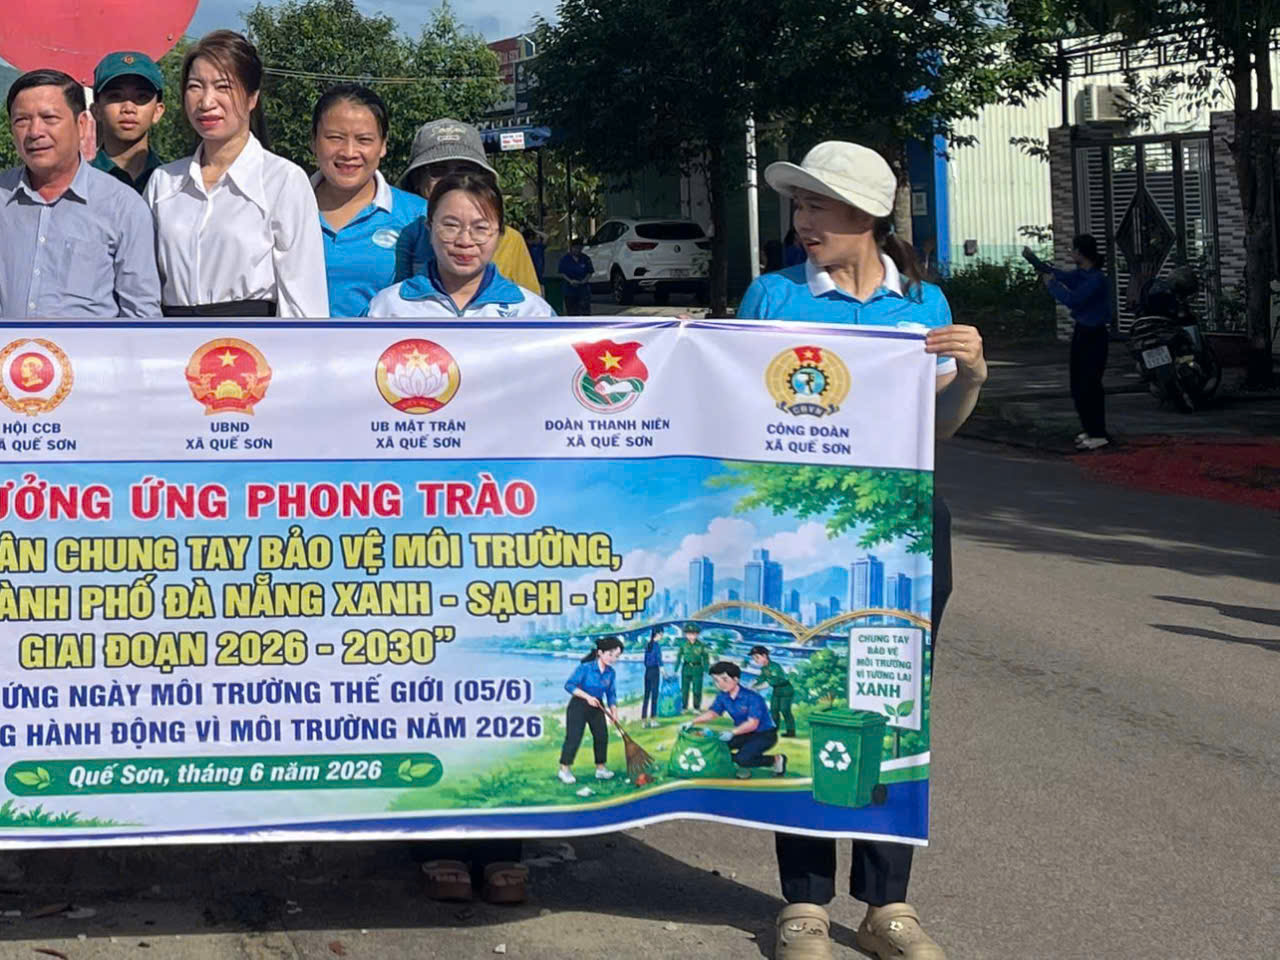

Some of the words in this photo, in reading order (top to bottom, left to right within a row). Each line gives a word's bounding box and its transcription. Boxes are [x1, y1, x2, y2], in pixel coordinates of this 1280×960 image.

[3, 421, 27, 435] HỘI
[32, 423, 61, 434] CCB
[210, 422, 249, 433] UBND
[371, 422, 389, 432] UB
[429, 419, 466, 435] TRẬN
[545, 417, 583, 431] ĐOÀN
[588, 420, 636, 430] THANH
[642, 418, 670, 430] NIÊN
[767, 422, 805, 436] CÔNG
[810, 425, 849, 438] ĐOÀN
[12, 436, 43, 452] QUẾ
[47, 439, 77, 450] SƠN
[186, 438, 204, 450] XÃ
[210, 435, 241, 450] QUẾ
[244, 438, 273, 449] SƠN
[376, 436, 394, 449] XÃ
[400, 434, 429, 449] QUẾ
[433, 437, 461, 448] SƠN
[566, 436, 586, 447] XÃ
[591, 433, 621, 448] QUẾ
[626, 436, 653, 447] SƠN
[765, 438, 783, 451] XÃ
[788, 439, 818, 454] QUẾ
[822, 442, 851, 455] SƠN
[131, 477, 228, 519] ỨNG
[247, 483, 401, 518] PHONG
[418, 474, 536, 516] TRÀO
[55, 536, 178, 572] CHUNG
[187, 536, 251, 571] TAY
[259, 525, 333, 569] BẢO
[340, 528, 386, 575] VỆ
[393, 527, 462, 568] MÔI
[470, 525, 622, 571] TRƯỜNG,
[78, 574, 157, 620] PHỐ
[163, 577, 216, 619] ĐÀ
[224, 573, 324, 617] NẴNG
[331, 581, 433, 617] XANH
[440, 593, 459, 608] -
[466, 578, 563, 623] SẠCH
[569, 591, 588, 606] -
[594, 577, 654, 620] ĐẸP
[858, 634, 890, 644] CHUNG
[893, 635, 909, 644] TAY
[19, 633, 95, 669] GIAI
[103, 632, 207, 673] ĐOẠN
[217, 630, 308, 667] 2026
[316, 642, 335, 657] -
[341, 626, 455, 666] 2030”
[856, 657, 873, 667] MÔI
[897, 671, 912, 682] LAI
[2, 682, 59, 709] ỨNG
[69, 680, 141, 708] NGÀY
[151, 678, 203, 707] MÔI
[213, 677, 321, 705] TRƯỜNG
[330, 673, 382, 703] THẾ
[390, 676, 443, 703] GIỚI
[454, 678, 532, 705] (05/6)
[856, 682, 901, 698] XANH
[27, 718, 101, 747] HÀNH
[110, 717, 185, 749] ĐỘNG
[195, 715, 220, 742] VÌ
[231, 715, 281, 741] MÔI
[291, 714, 397, 741] TRƯỜNG
[407, 712, 466, 739] NĂM
[476, 716, 542, 738] 2026
[69, 762, 119, 786] Quế
[121, 764, 170, 787] Sơn,
[178, 762, 243, 786] tháng
[250, 762, 264, 782] 6
[270, 761, 320, 781] năm
[325, 760, 382, 781] 2026
